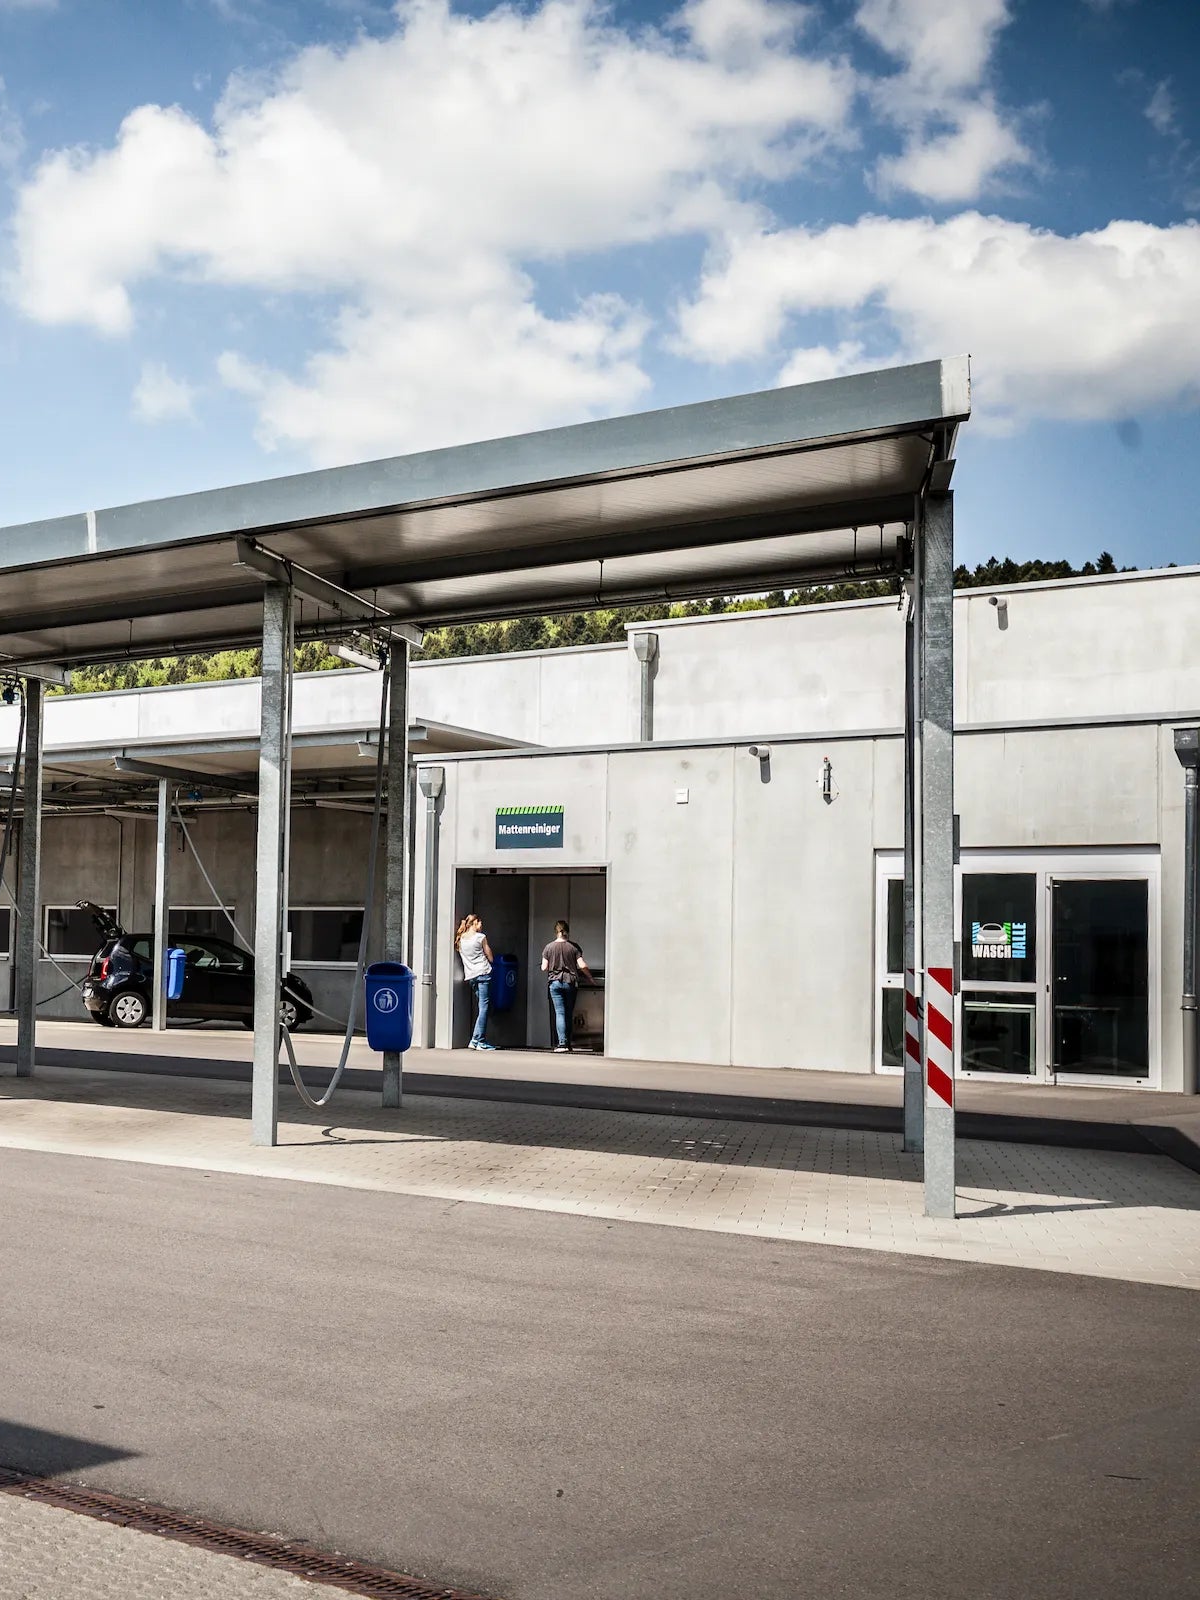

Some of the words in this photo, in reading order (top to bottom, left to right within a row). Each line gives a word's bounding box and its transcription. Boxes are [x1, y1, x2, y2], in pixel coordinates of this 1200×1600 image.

[498, 823, 560, 836] Mattenreiniger
[1012, 922, 1026, 958] HALLE
[972, 944, 1011, 958] WASCH
